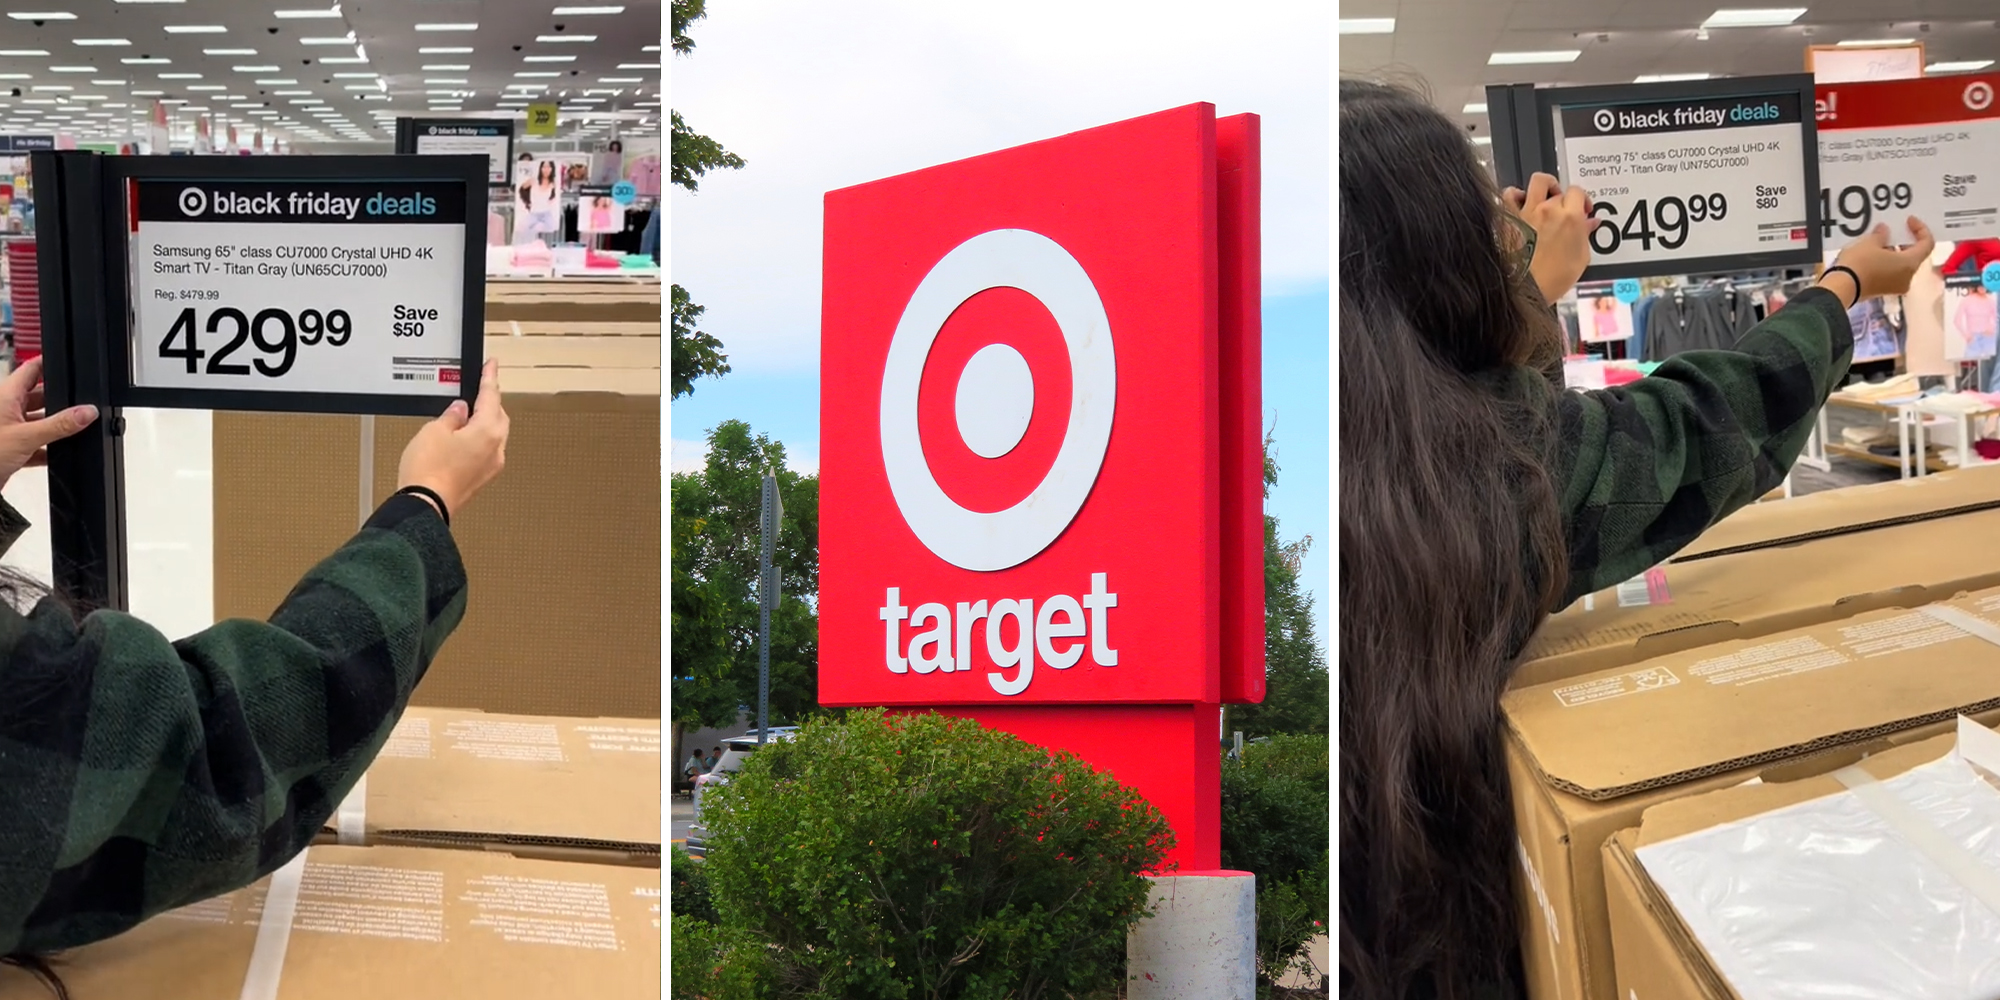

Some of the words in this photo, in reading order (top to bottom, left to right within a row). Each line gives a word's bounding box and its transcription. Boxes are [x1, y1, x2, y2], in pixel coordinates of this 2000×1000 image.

[1815, 92, 1837, 120] e!
[1619, 109, 1670, 129] black
[1673, 106, 1726, 126] friday
[1730, 102, 1779, 121] deals
[458, 127, 478, 135] friday
[1578, 153, 1621, 165] Samsung
[1641, 150, 1666, 161] class
[1668, 147, 1706, 159] CU7000
[1708, 144, 1740, 158] Crystal
[1743, 142, 1765, 153] UHD
[1767, 141, 1780, 152] 4K
[1579, 167, 1607, 177] Smart
[1609, 165, 1622, 176] TV
[1630, 163, 1654, 174] Titan
[1655, 161, 1678, 174] Gray
[1680, 156, 1749, 171] (UN75CU7000)
[1943, 174, 1977, 186] Save
[1599, 187, 1630, 196] $729.99
[1756, 185, 1788, 197] Save
[213, 191, 282, 214] black
[288, 191, 361, 220] friday
[366, 192, 437, 215] deals
[1756, 197, 1779, 209] $80
[153, 244, 212, 260] Samsung
[215, 245, 236, 258] 65"
[240, 246, 272, 258] class
[276, 246, 328, 259] CU7000
[331, 246, 376, 262] Crystal
[380, 247, 411, 260] UHD
[415, 247, 434, 260] 4K
[153, 261, 191, 274] Smart
[194, 262, 211, 274] TV
[223, 262, 254, 275] Titan
[257, 262, 288, 278] Gray
[291, 263, 388, 278] (UN65CU7000)
[154, 289, 178, 301] Reg.
[179, 289, 220, 300] $479.99
[393, 305, 439, 321] Save
[392, 322, 425, 338] $50
[879, 572, 1118, 696] target
